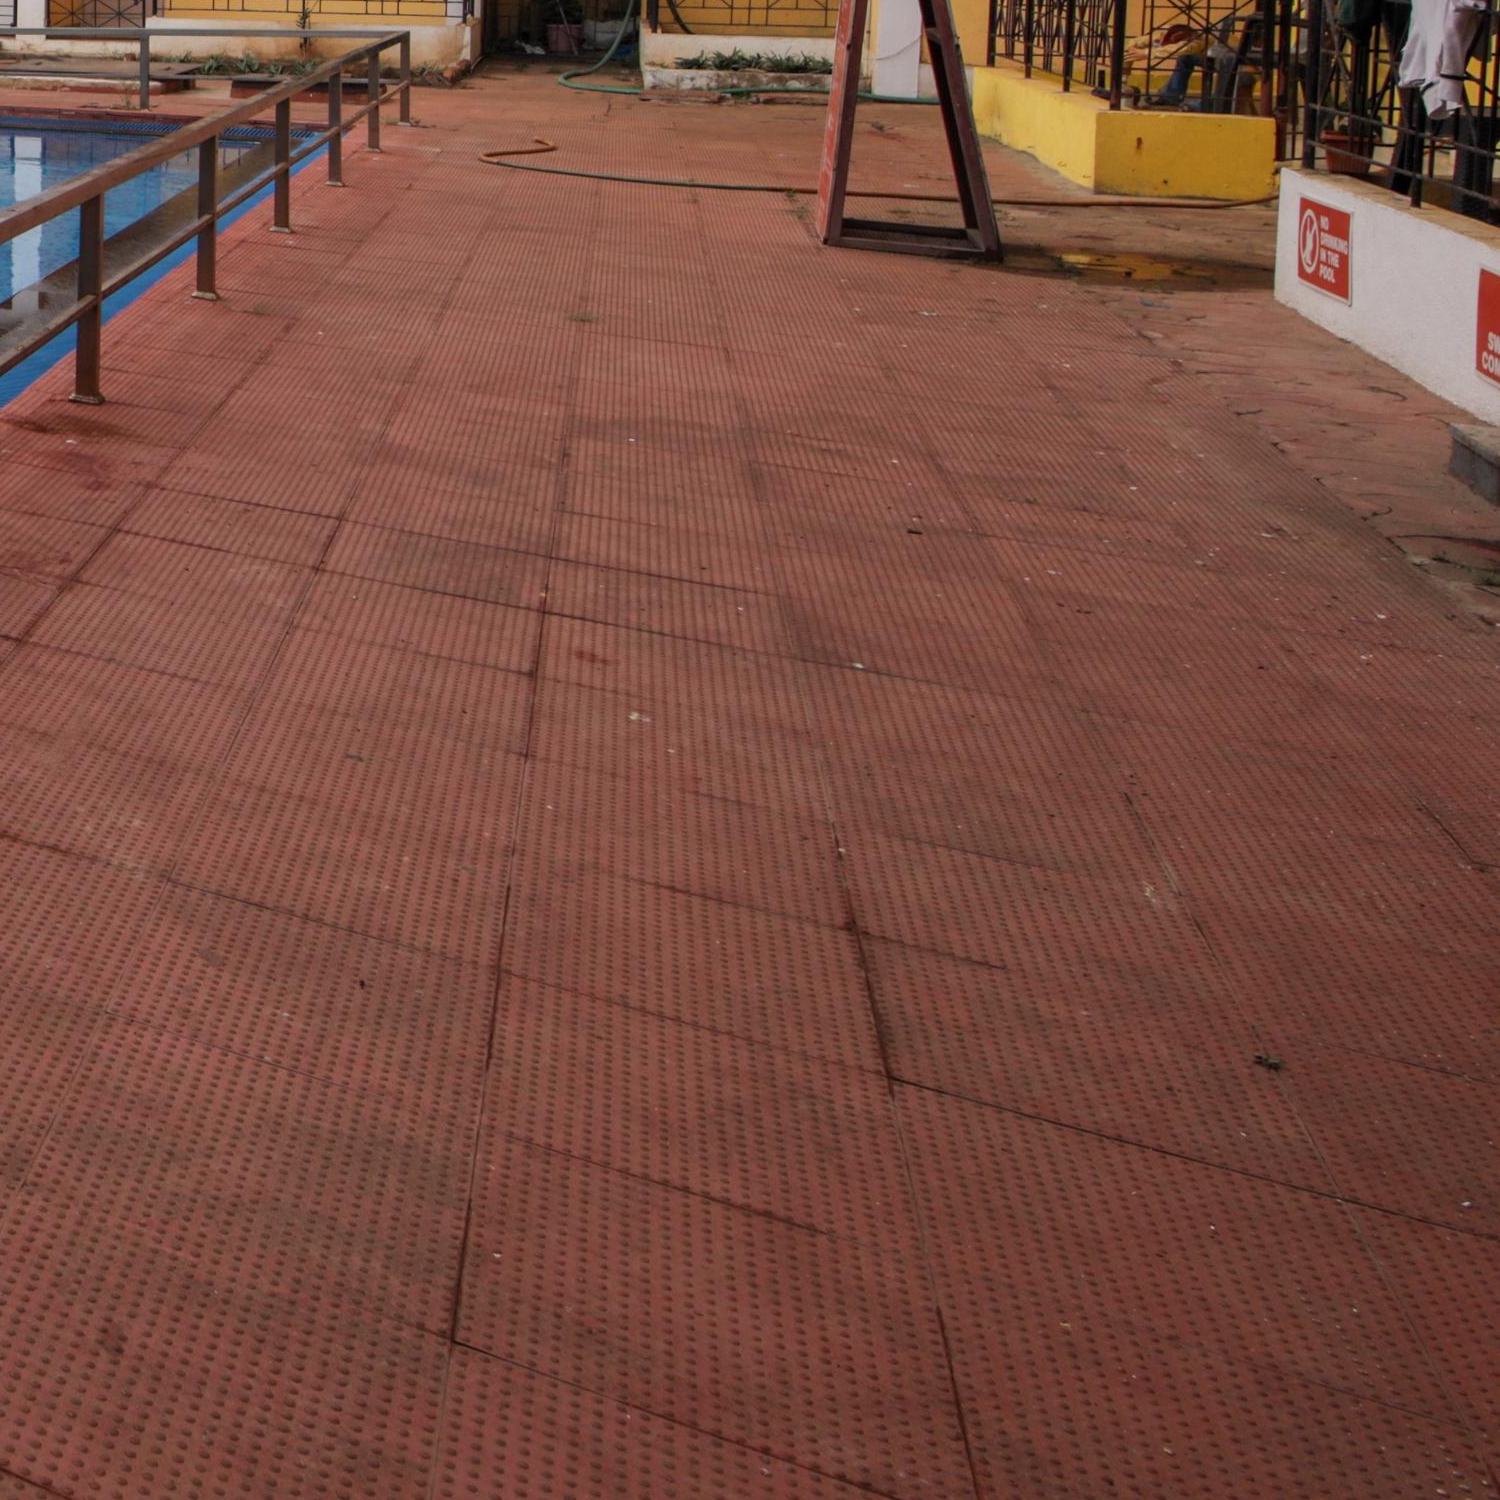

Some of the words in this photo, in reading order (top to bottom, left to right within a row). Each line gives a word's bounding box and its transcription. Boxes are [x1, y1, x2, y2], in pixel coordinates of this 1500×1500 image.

[1320, 214, 1329, 231] NO
[1320, 231, 1348, 255] DRINKING
[1319, 247, 1327, 263] IN
[1327, 250, 1340, 268] THE
[1319, 263, 1336, 283] POOL
